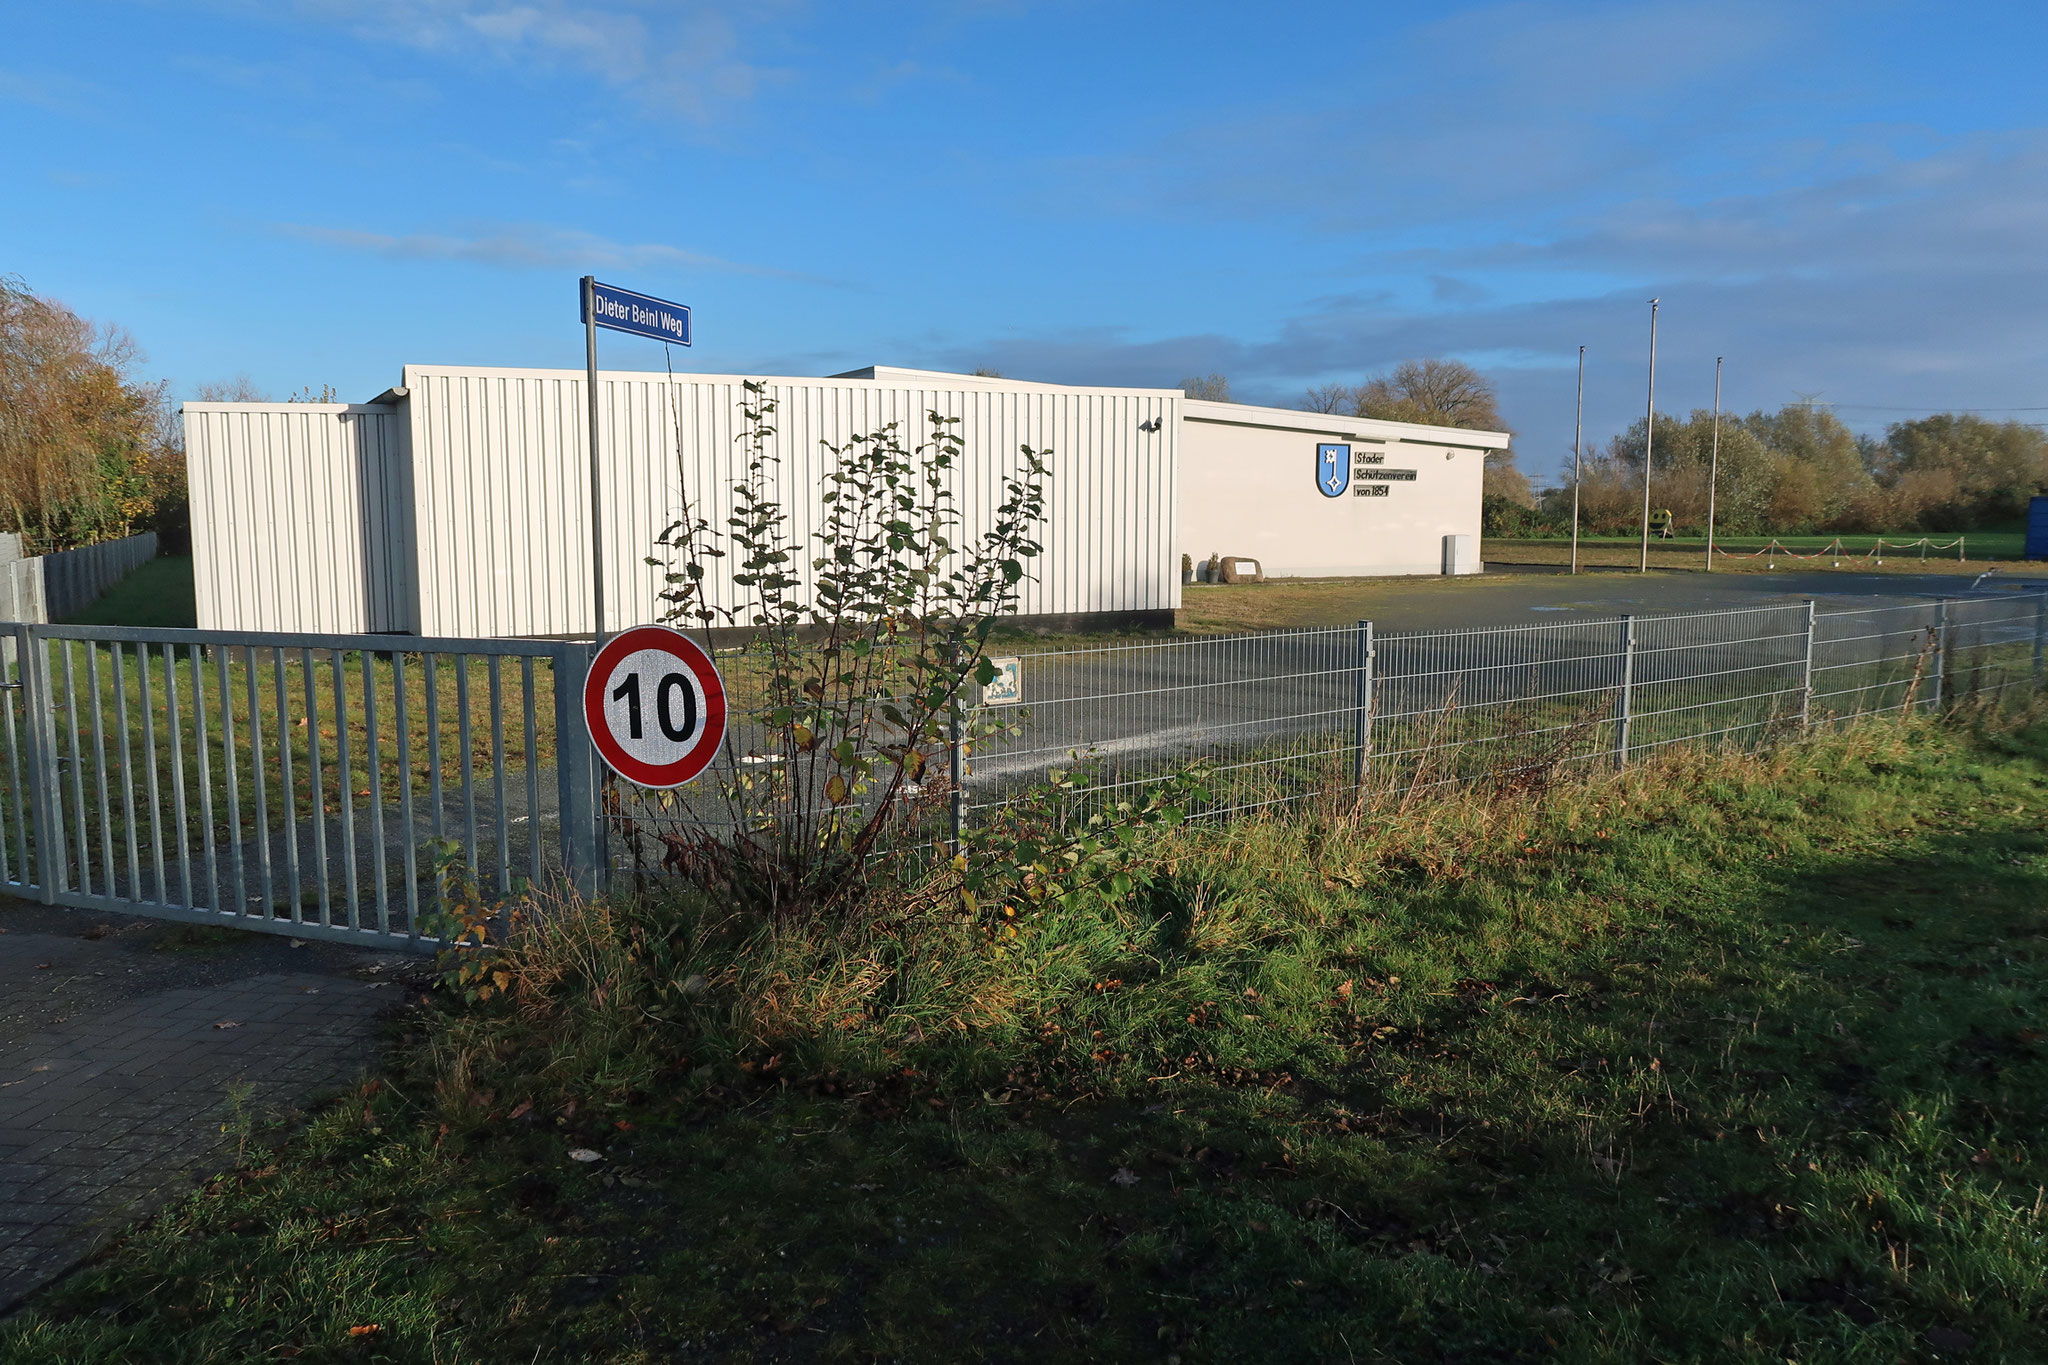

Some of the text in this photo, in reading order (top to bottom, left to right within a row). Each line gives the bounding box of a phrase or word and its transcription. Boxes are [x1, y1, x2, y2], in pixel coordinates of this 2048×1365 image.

[596, 295, 683, 337] Dieter Beinl Weg
[1357, 453, 1384, 463] Stader
[1356, 469, 1416, 480] Schützenverein
[1356, 485, 1389, 496] von 1854
[613, 672, 697, 742] 10
